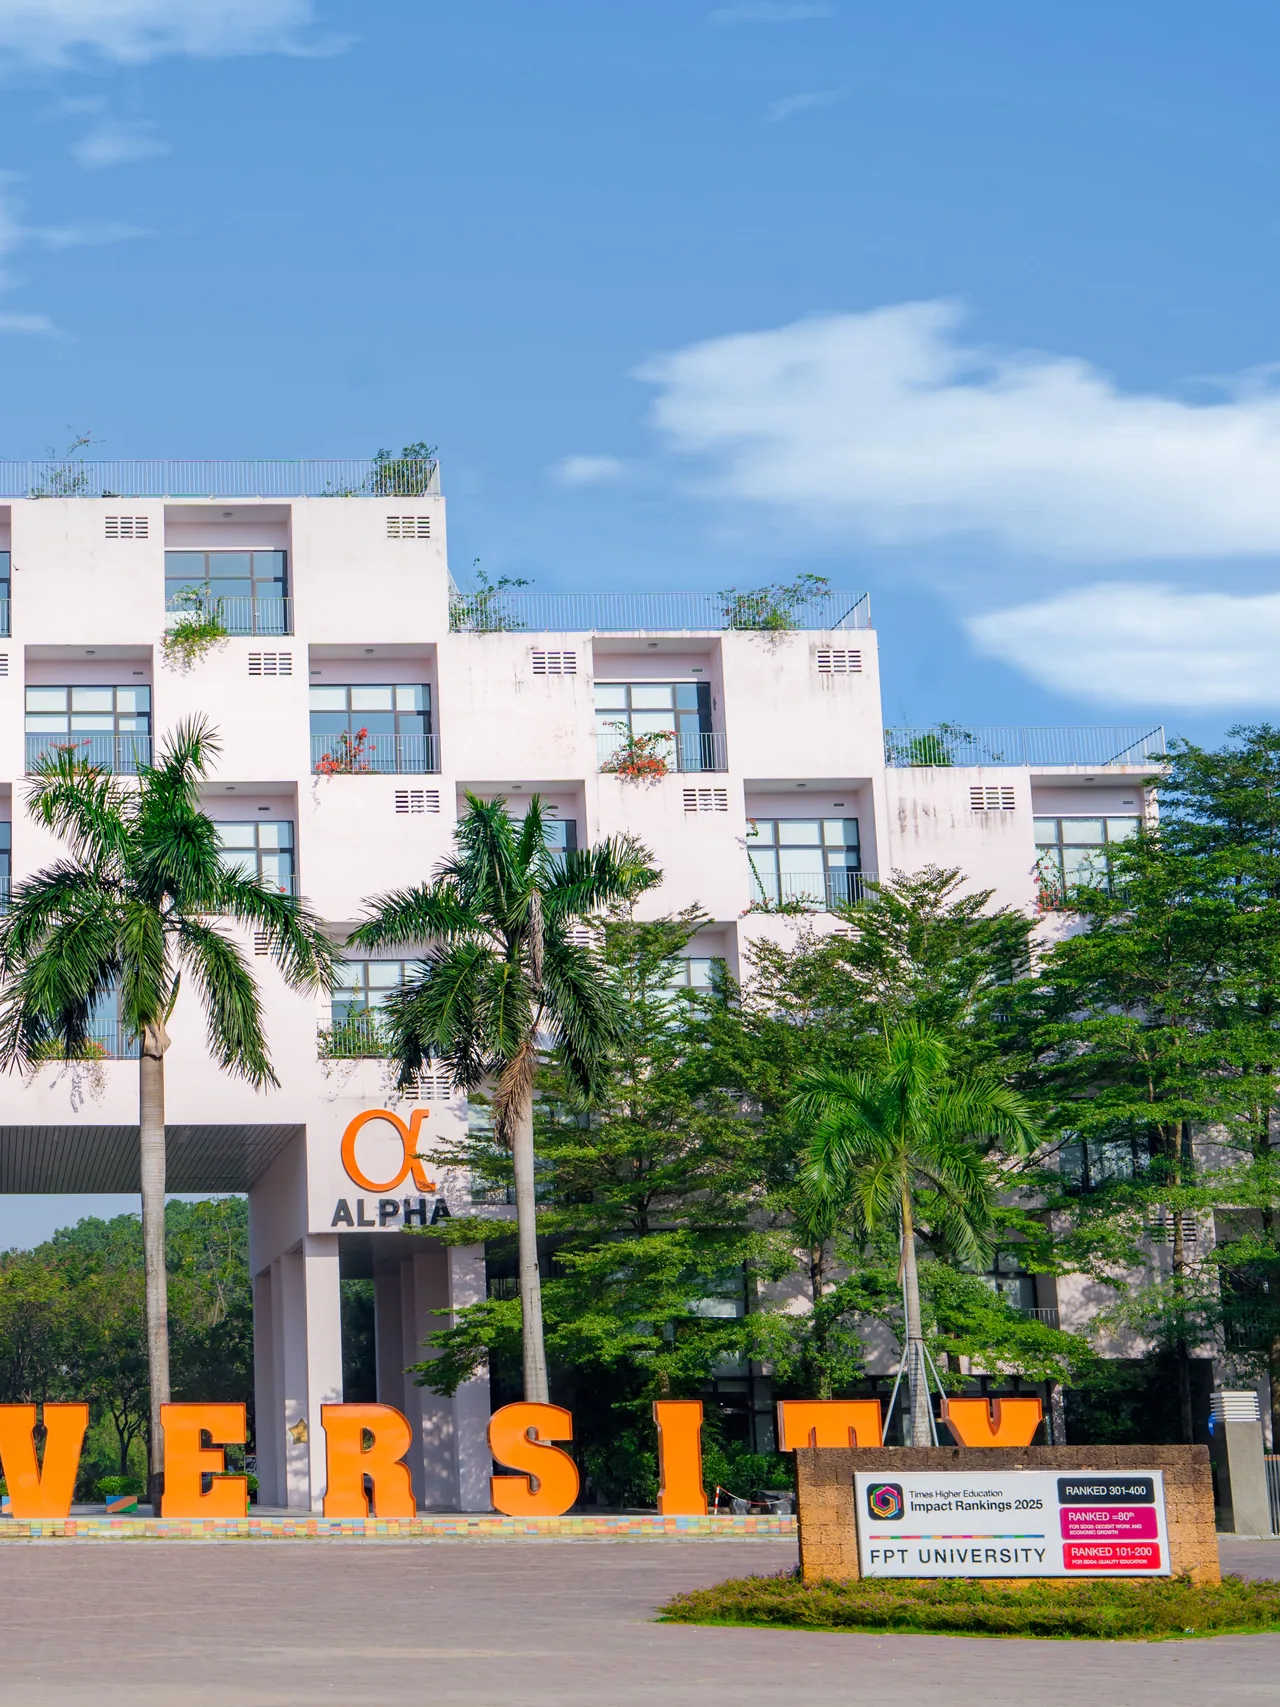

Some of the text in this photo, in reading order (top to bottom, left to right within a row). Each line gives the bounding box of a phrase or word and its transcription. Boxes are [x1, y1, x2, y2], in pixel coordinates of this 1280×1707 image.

[331, 1198, 451, 1227] ALPHA
[909, 1489, 1003, 1499] Times Higher Education
[1065, 1486, 1146, 1496] RANKED 301-400
[910, 1499, 1043, 1514] Impact Rankings 2025
[1068, 1512, 1109, 1521] RANKED
[870, 1548, 1046, 1564] FPT UNIVERSITY
[1071, 1547, 1152, 1556] RANKED 101-200
